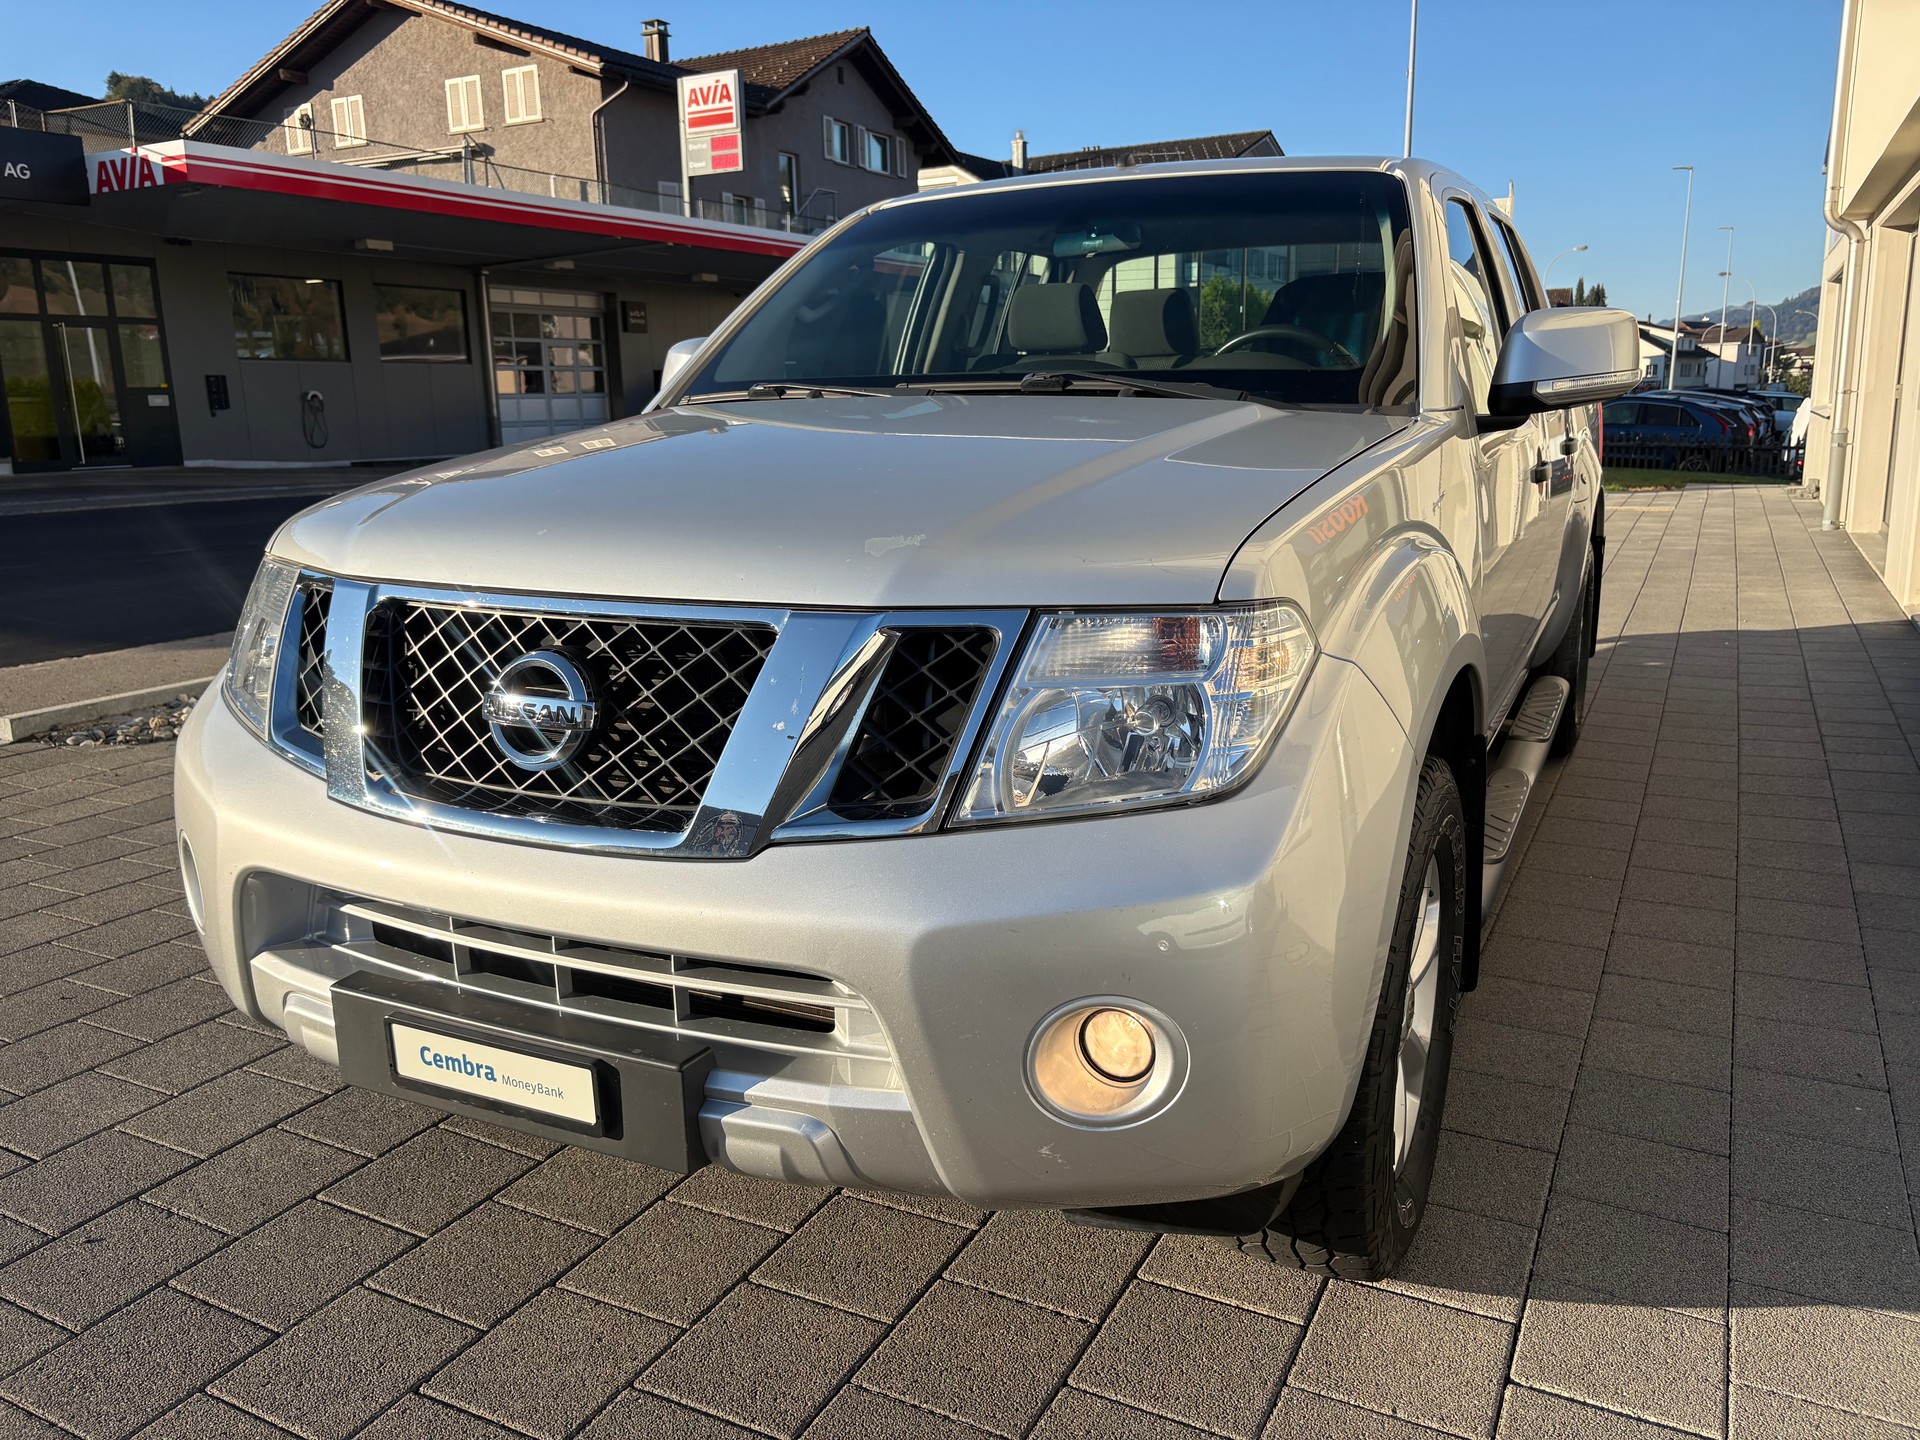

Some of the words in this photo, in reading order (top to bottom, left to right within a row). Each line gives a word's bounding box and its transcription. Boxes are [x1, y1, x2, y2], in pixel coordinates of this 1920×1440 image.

[4, 162, 31, 180] AG
[96, 147, 157, 194] AVIA
[486, 698, 576, 726] NISSAN
[419, 1045, 497, 1083] Cembra
[502, 1074, 564, 1099] MoneyBank
